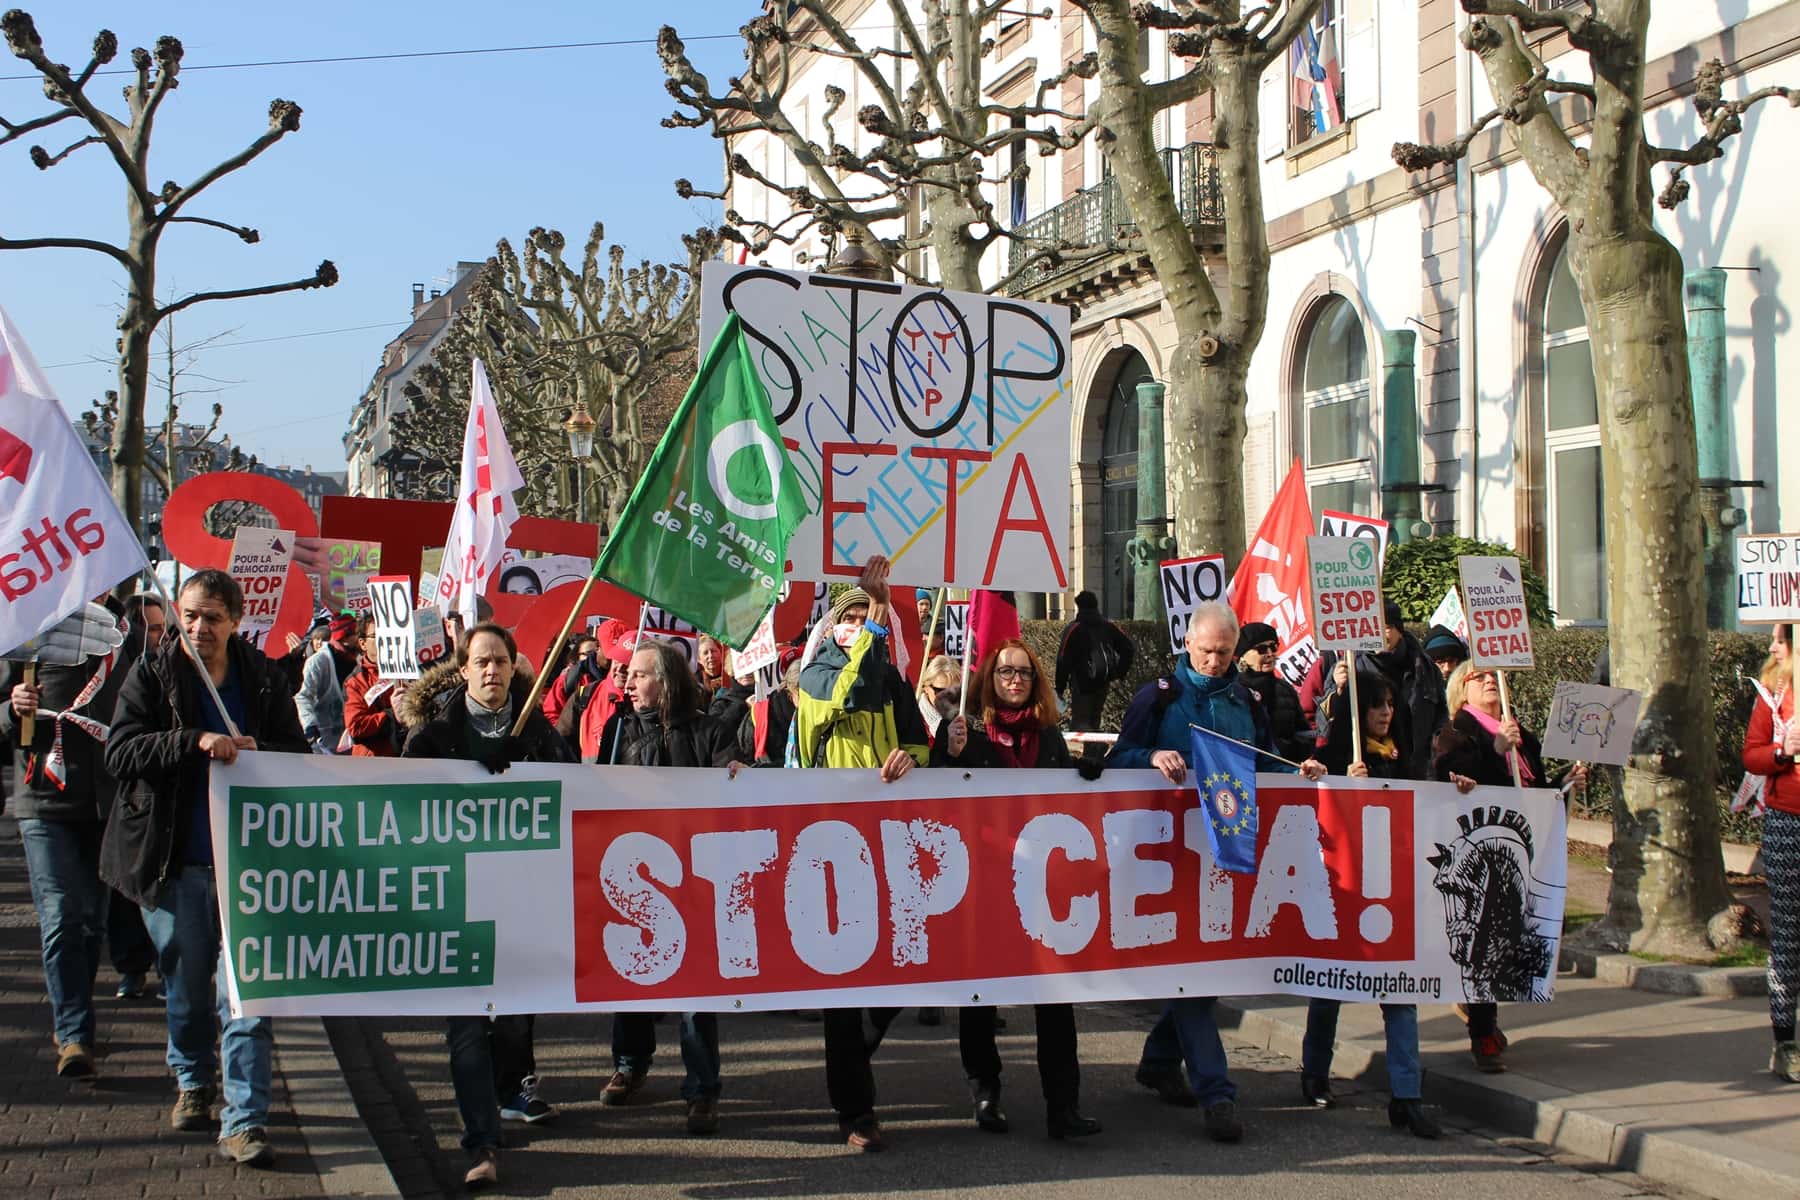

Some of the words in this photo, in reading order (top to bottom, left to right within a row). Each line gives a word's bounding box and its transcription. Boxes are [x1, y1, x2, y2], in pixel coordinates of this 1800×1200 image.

[722, 268, 1066, 446] STOP
[673, 490, 714, 525] Les
[718, 521, 777, 564] Amis
[782, 437, 1069, 588] ETA
[234, 554, 258, 564] POUR
[260, 554, 272, 563] LA
[652, 510, 682, 532] de
[686, 525, 707, 549] la
[715, 543, 776, 590] Terre
[1315, 561, 1348, 574] POUR
[1741, 539, 1788, 565] STOP
[233, 575, 282, 595] TOP
[1162, 561, 1222, 609] NO
[1316, 577, 1330, 589] LE
[1333, 575, 1376, 588] CLIMAT
[1467, 585, 1491, 596] POUR
[1493, 584, 1505, 594] LA
[1738, 571, 1764, 609] LET
[1769, 571, 1800, 608] HUM
[370, 583, 410, 628] NO
[1320, 590, 1376, 615] STOP
[1473, 608, 1522, 632] STOP
[1321, 615, 1380, 642] CETA!
[1476, 632, 1529, 658] CETA!
[241, 802, 344, 848] POUR
[358, 800, 401, 847] LA
[411, 796, 551, 844] JUSTICE
[238, 867, 399, 915] SOCIALE
[411, 865, 451, 912] ET
[1011, 804, 1393, 955] CETA!
[600, 817, 970, 986] STOP
[1273, 963, 1441, 998] collectifstoptafta.org
